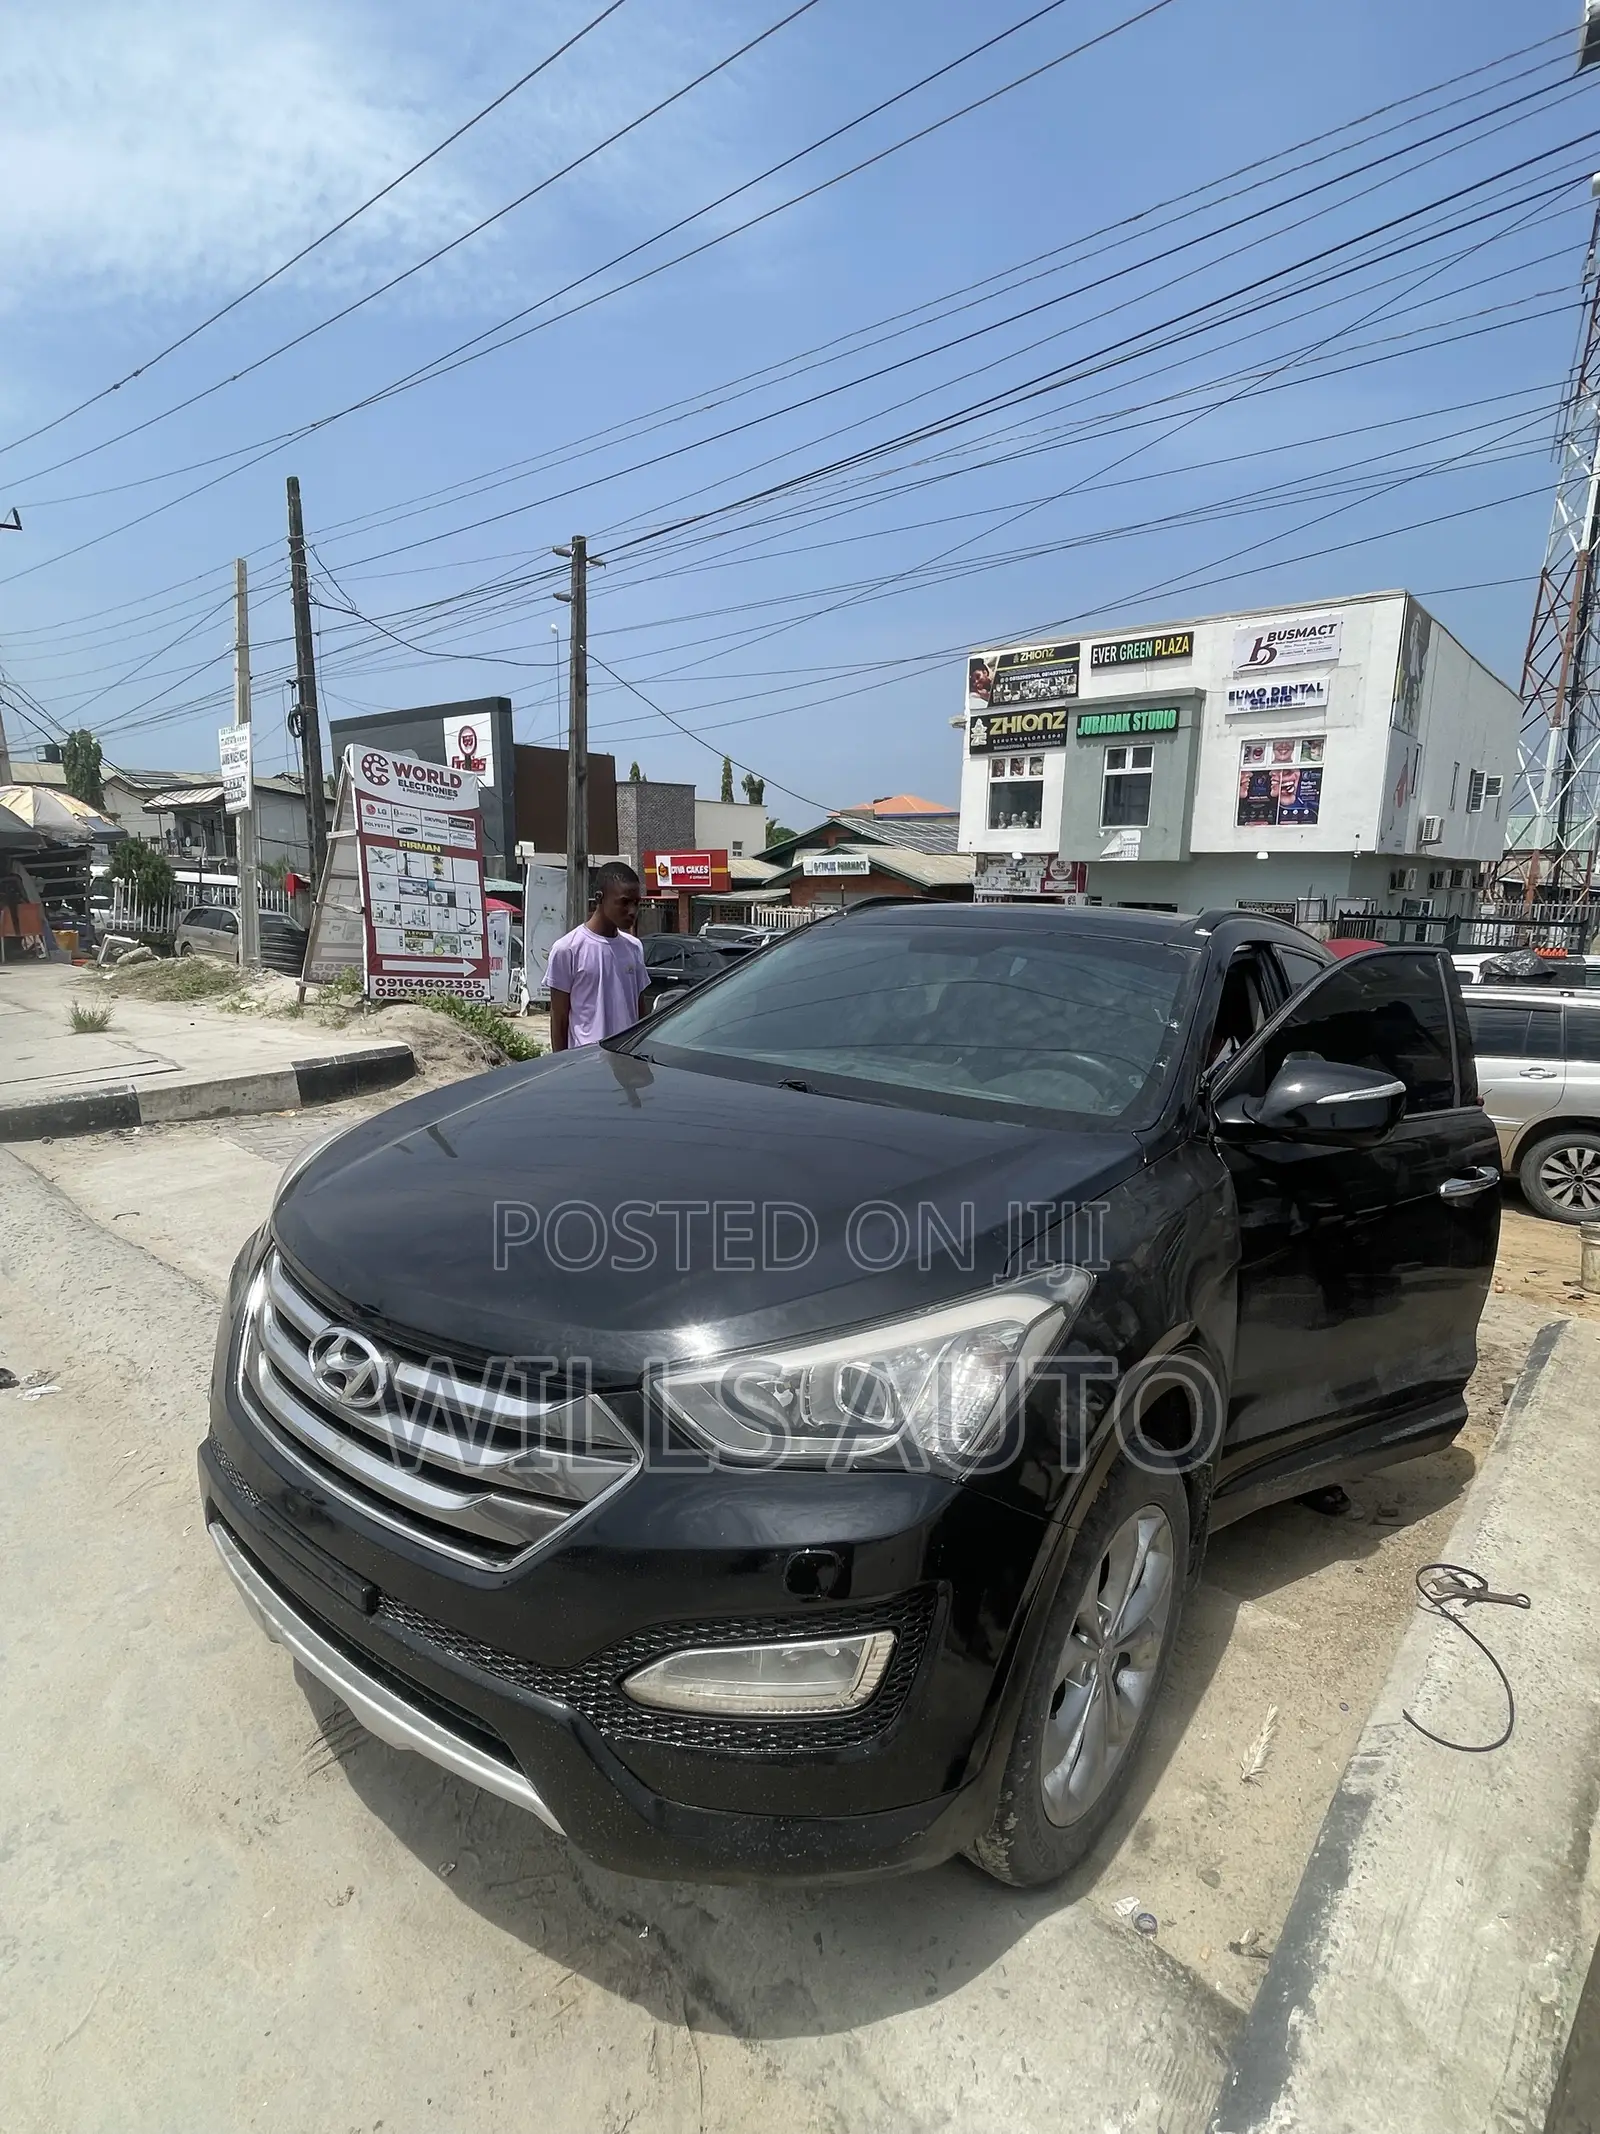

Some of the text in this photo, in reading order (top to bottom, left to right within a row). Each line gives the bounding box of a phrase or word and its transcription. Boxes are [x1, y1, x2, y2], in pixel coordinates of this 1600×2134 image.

[1267, 623, 1337, 642] BUSMACT
[1092, 636, 1189, 664] EVER GREEN PLAZA
[1271, 682, 1323, 696] DENTAL
[1250, 695, 1292, 705] CLINIC
[1077, 710, 1177, 735] JUBADAK STUDIO
[392, 761, 462, 789] WORLD
[399, 840, 441, 853] FIRMAN
[671, 865, 709, 875] DIVA CAKES
[375, 978, 485, 990] 09164602395,
